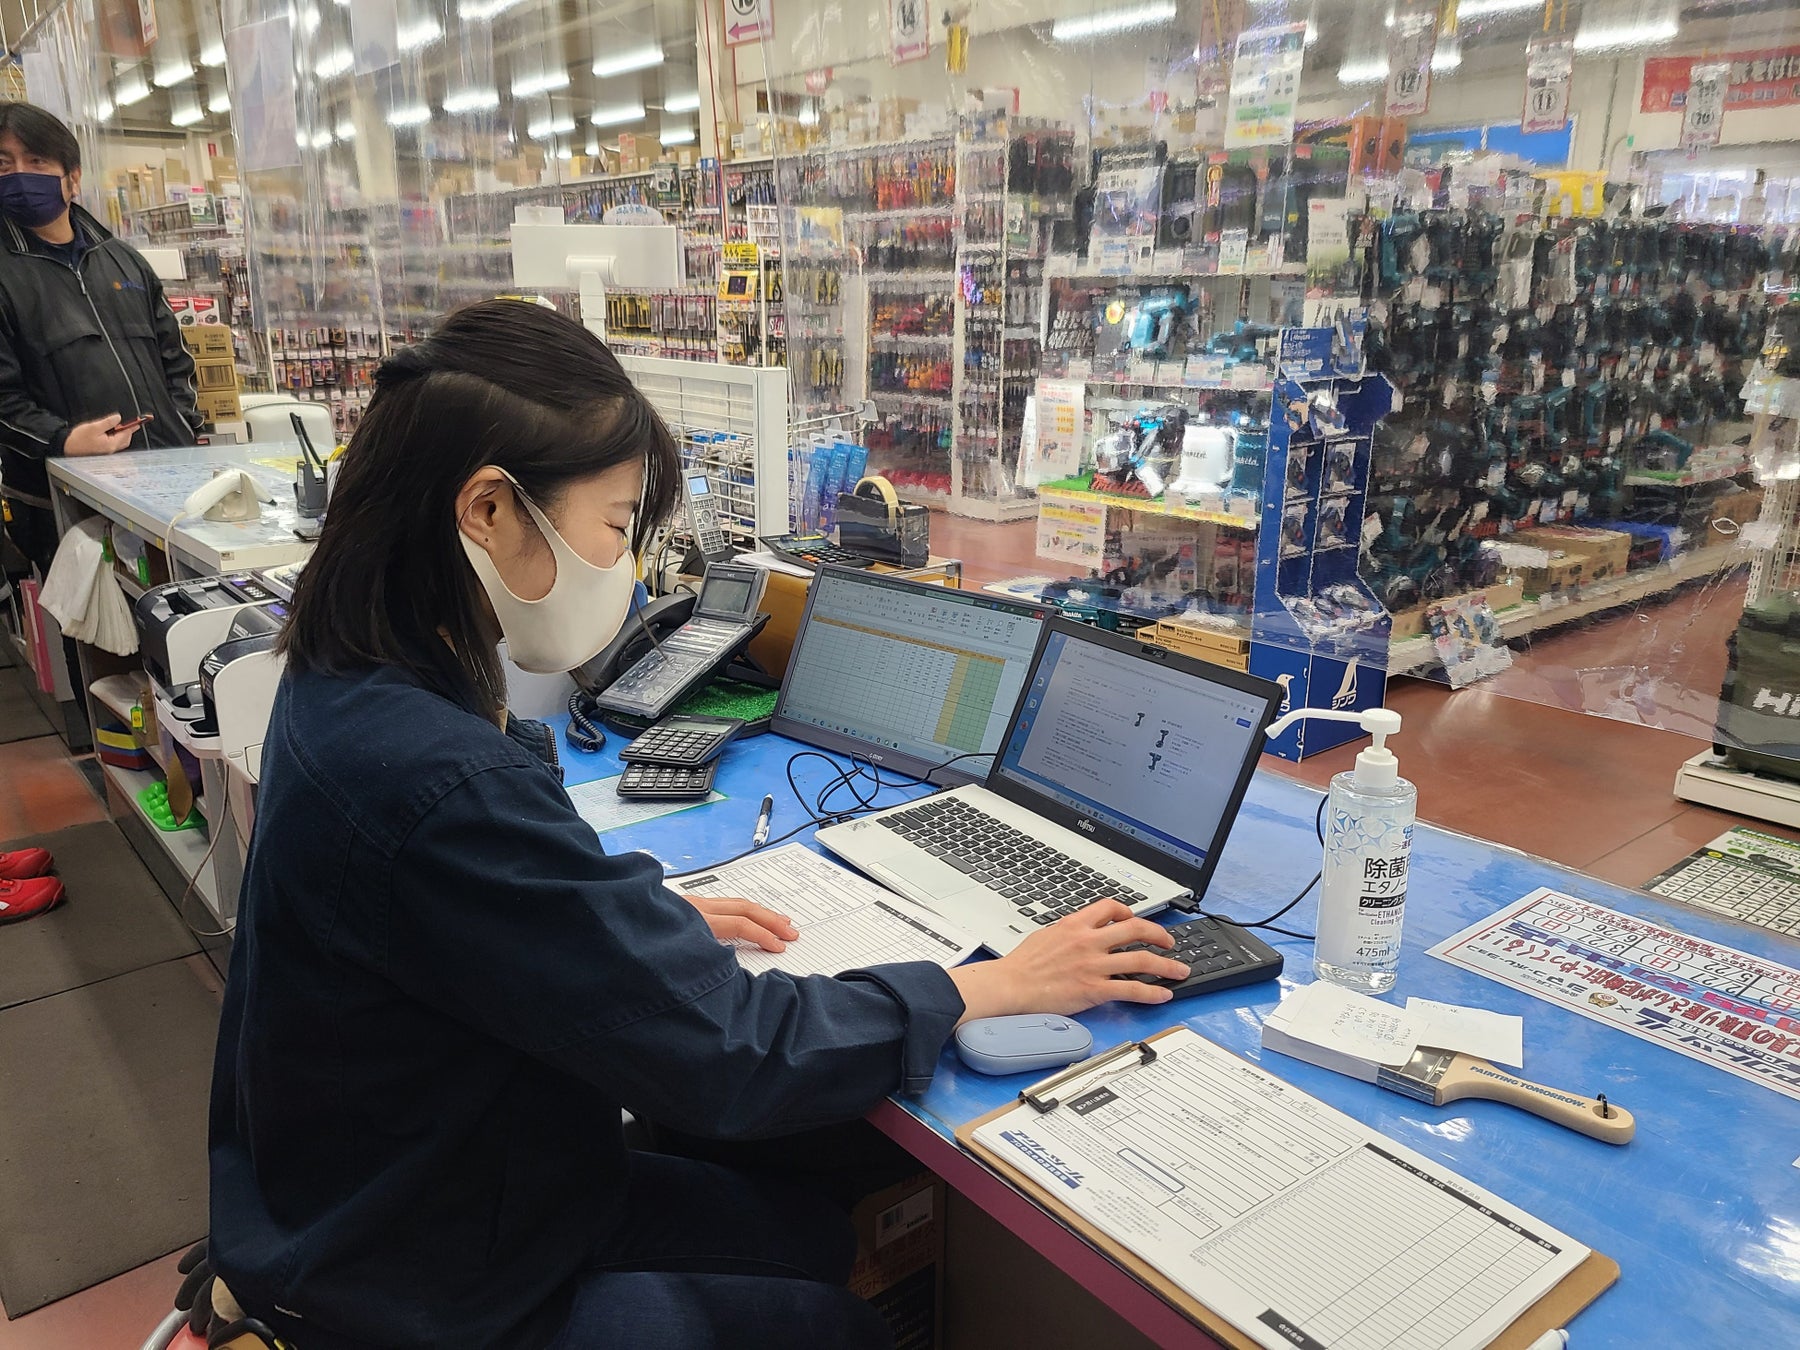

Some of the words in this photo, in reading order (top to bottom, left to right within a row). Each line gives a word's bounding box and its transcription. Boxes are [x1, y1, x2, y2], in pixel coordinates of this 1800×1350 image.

[1076, 819, 1096, 833] FUJITSU
[1364, 852, 1411, 879] 除菌
[1577, 933, 1625, 954] 3/27
[1592, 924, 1638, 943] 6/26
[1356, 946, 1390, 957] 475ml
[1704, 961, 1753, 983] 5/22
[1690, 972, 1741, 994] 2/27
[1634, 1013, 1800, 1088] アクトツール
[1469, 1065, 1519, 1086] PAINTING
[1009, 1129, 1086, 1184] アクトツール
